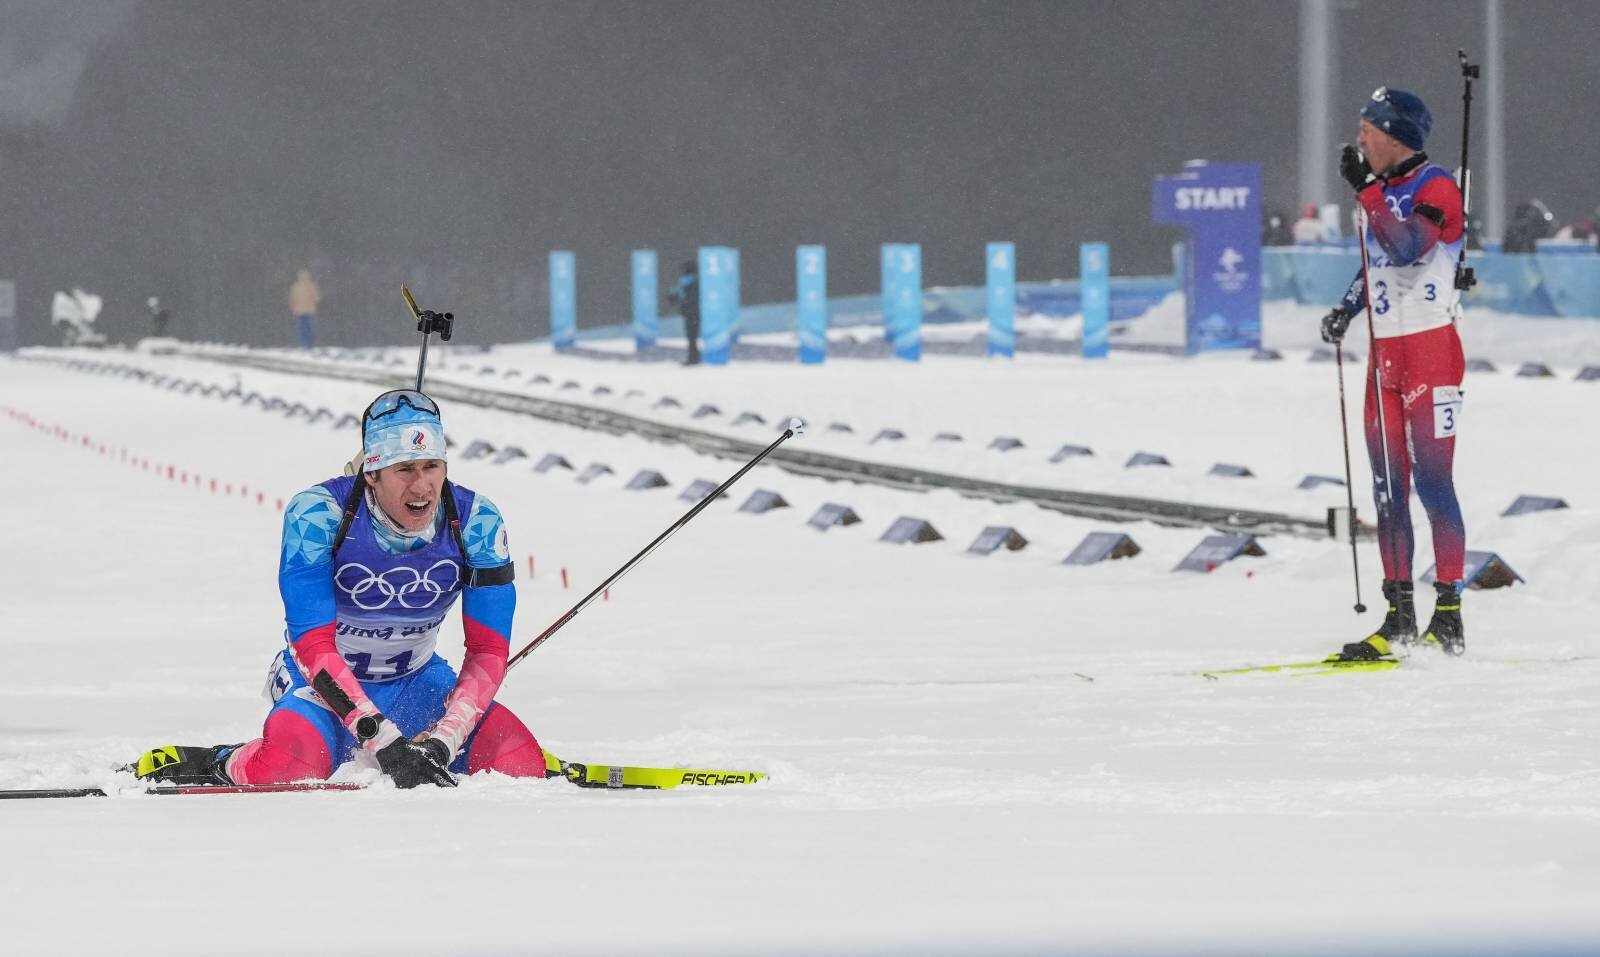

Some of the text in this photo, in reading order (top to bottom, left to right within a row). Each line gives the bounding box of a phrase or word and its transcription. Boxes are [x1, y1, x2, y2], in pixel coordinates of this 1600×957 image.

[1174, 187, 1249, 210] START
[708, 255, 720, 275] 1
[992, 250, 1008, 269] 4
[1375, 280, 1391, 315] 3
[1424, 283, 1437, 301] 3
[1443, 407, 1454, 431] 3
[345, 649, 414, 681] 11
[681, 772, 745, 786] FISCHER
